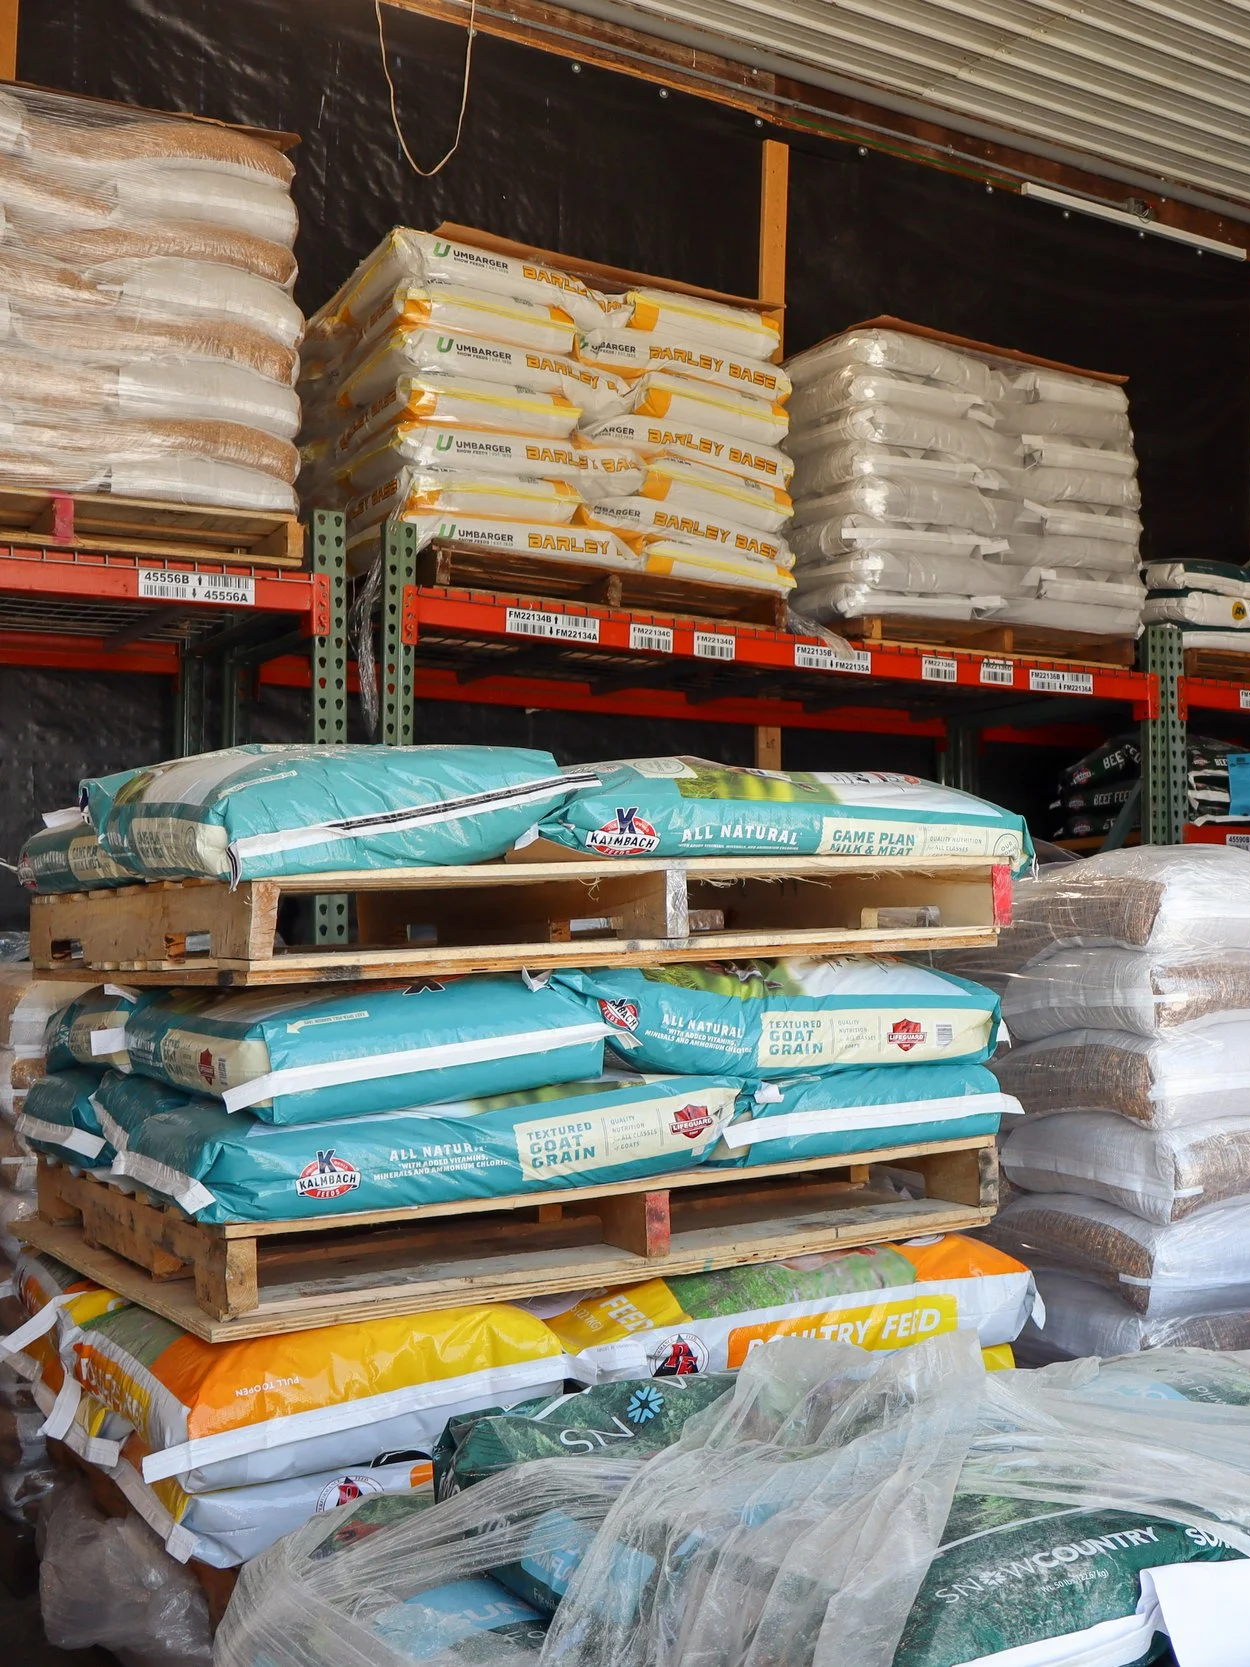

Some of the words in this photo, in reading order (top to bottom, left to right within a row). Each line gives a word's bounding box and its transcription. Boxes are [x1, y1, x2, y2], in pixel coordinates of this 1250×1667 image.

[453, 250, 509, 270] UMBARGER
[456, 343, 512, 360] UMBARGER
[525, 354, 600, 389] BARLEY
[649, 346, 724, 372] BARLEY
[728, 363, 777, 390] BASE
[456, 440, 512, 454] UMBARGER
[648, 428, 725, 457] BARLEY
[728, 447, 778, 476] BASE
[458, 529, 514, 542] UMBARGER
[653, 511, 731, 543] BARLEY
[735, 534, 779, 561] BASE
[528, 533, 610, 555] BARLEY
[144, 572, 190, 584] 45556B
[204, 590, 248, 602] 45556A
[508, 610, 552, 623] FM22134B
[556, 628, 598, 641] FM22134A
[633, 626, 671, 638] FM22134C
[696, 635, 734, 646] FM22134D
[796, 646, 832, 657] FM22135B
[835, 662, 870, 672] FM22135A
[1031, 672, 1061, 680] FM22136B
[1063, 684, 1092, 693] FM22136A
[681, 827, 714, 843] ALL
[719, 824, 799, 846] NATURAL
[833, 829, 875, 843] GAME
[878, 831, 915, 846] PLAN
[952, 837, 982, 845] NUTRITION
[1228, 836, 1250, 844] 45590B
[590, 834, 657, 850] KALMBACH
[830, 844, 863, 855] MILK
[864, 846, 875, 856] &
[877, 846, 913, 856] MEAT
[602, 1006, 619, 1024] FEEDS
[662, 1014, 684, 1027] ALL
[688, 1019, 744, 1039] NATURAL
[769, 1020, 822, 1028] TEXTURED
[645, 1030, 676, 1042] MINERALS
[676, 1036, 689, 1044] AND
[689, 1038, 725, 1050] AMMONIUM
[685, 1031, 706, 1040] ADDED
[769, 1030, 814, 1042] GOAT
[889, 1033, 924, 1042] LIFEGUARD
[769, 1042, 823, 1056] GRAIN
[610, 1115, 635, 1126] QUALITY
[527, 1122, 592, 1141] TEXTURED
[612, 1122, 645, 1134] NUTRITION
[632, 1128, 658, 1138] CLASSES
[530, 1134, 583, 1156] GOAT
[620, 1142, 640, 1150] GOATS
[389, 1148, 417, 1162] ALL
[422, 1159, 449, 1168] ADDED
[450, 1154, 490, 1164] VITAMINS,
[531, 1146, 596, 1169] GRAIN
[374, 1170, 413, 1181] MINERALS
[414, 1168, 430, 1176] AND
[431, 1163, 475, 1174] AMMONIUM
[299, 1174, 356, 1190] KALMBACH
[316, 1188, 340, 1198] FEEDS
[882, 1308, 941, 1344] FEED
[262, 1383, 274, 1391] TO
[278, 1376, 300, 1387] PULL
[236, 1385, 262, 1397] OPEN
[1054, 1580, 1064, 1591] 50
[1096, 1568, 1110, 1580] kg)
